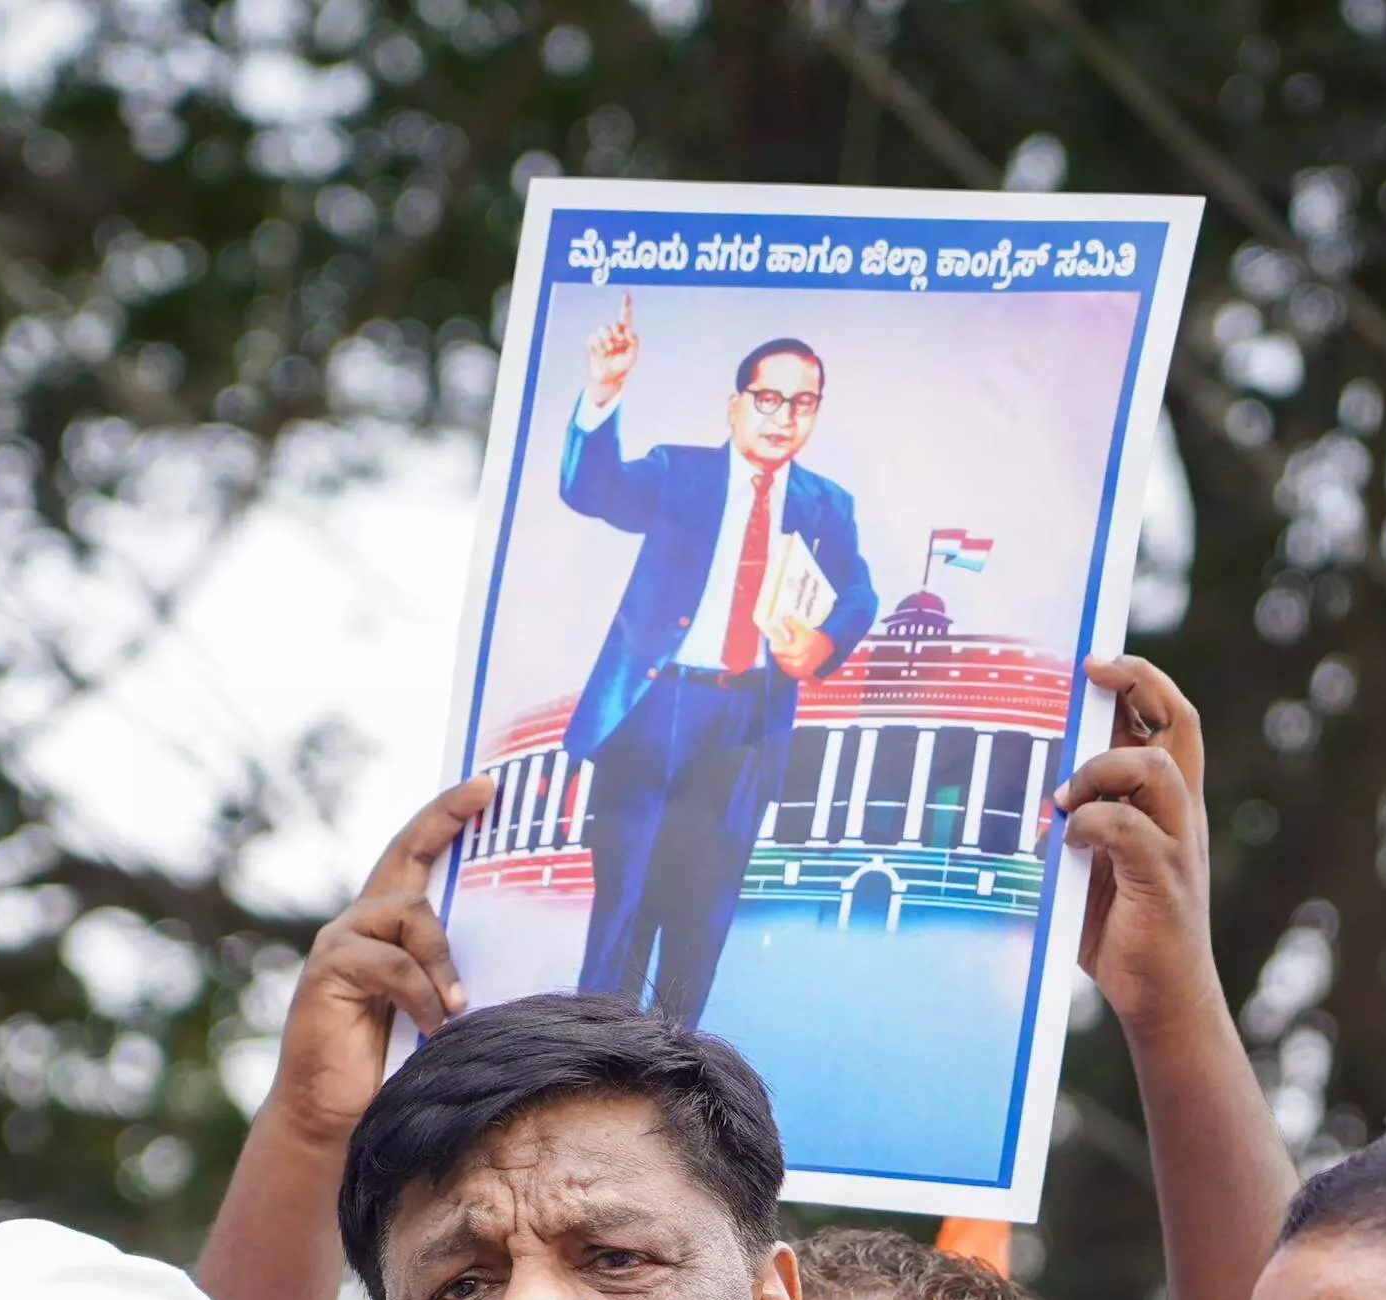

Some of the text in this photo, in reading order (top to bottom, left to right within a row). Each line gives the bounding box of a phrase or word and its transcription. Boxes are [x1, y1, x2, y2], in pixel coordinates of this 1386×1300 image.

[568, 228, 1137, 291] ಮೈಸೂರು ನಗರ ಹಾಗೂ ಜಿಲ್ಲಾ ಕಾಂಗ್ರೆಸ್ ಸಮಿತಿ
